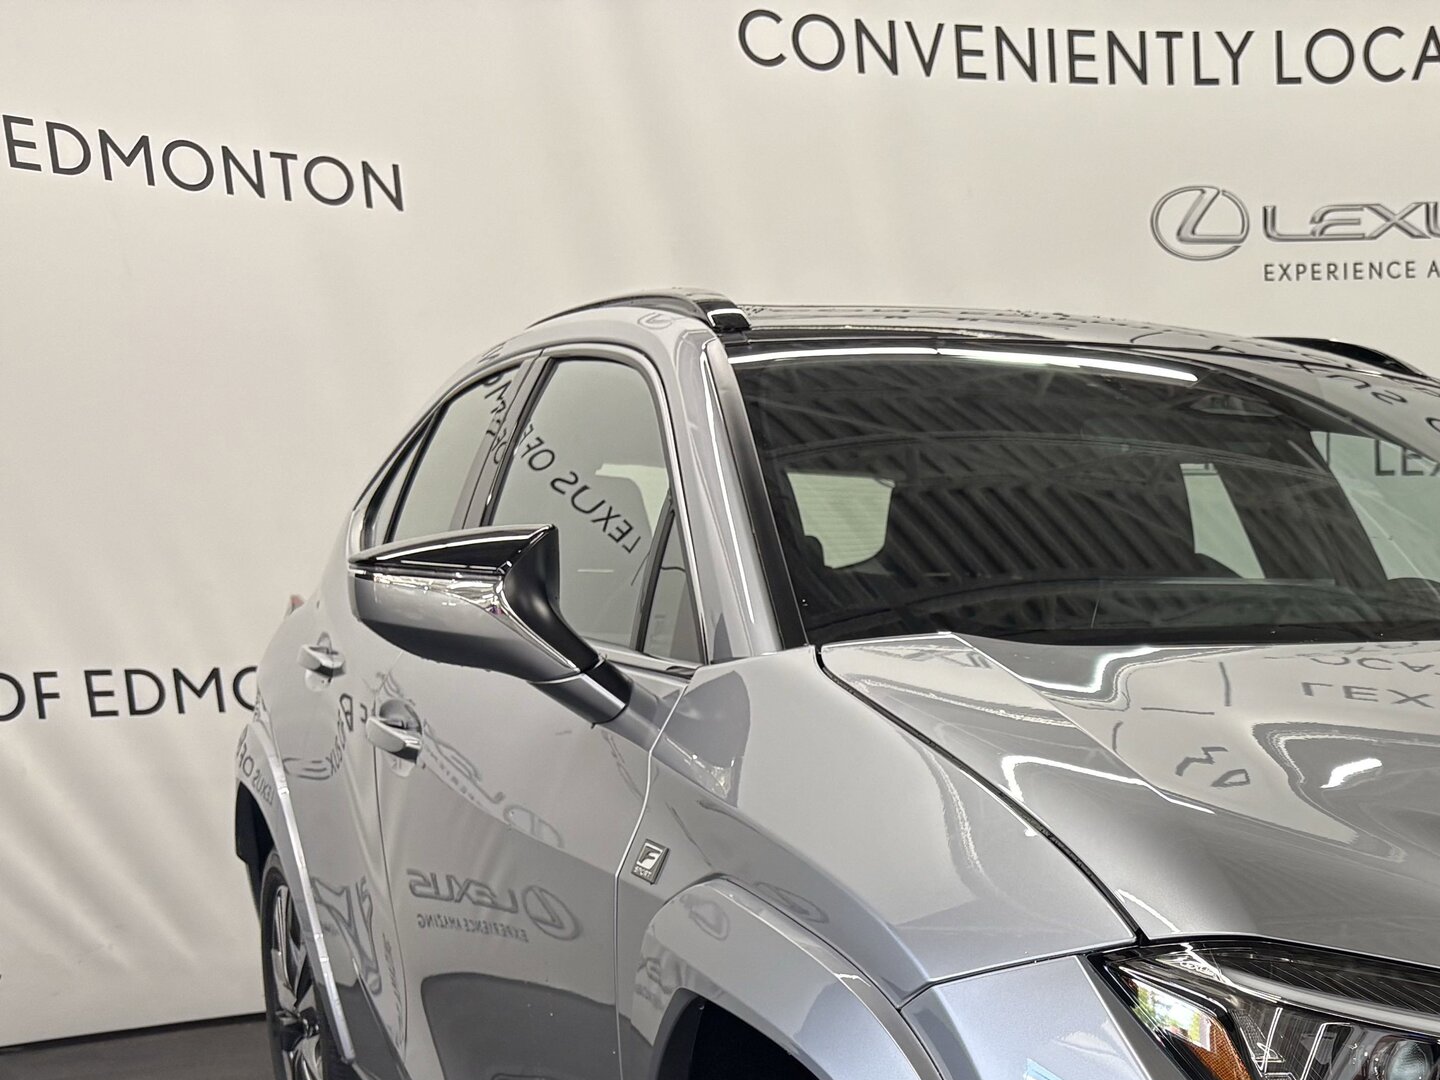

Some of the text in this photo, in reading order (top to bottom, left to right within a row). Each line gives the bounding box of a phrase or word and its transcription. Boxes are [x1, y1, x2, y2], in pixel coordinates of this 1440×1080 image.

[738, 9, 1255, 86] CONVENIENTLY
[2, 115, 404, 212] EDMONTON
[1263, 261, 1417, 282] EXPERIENCE
